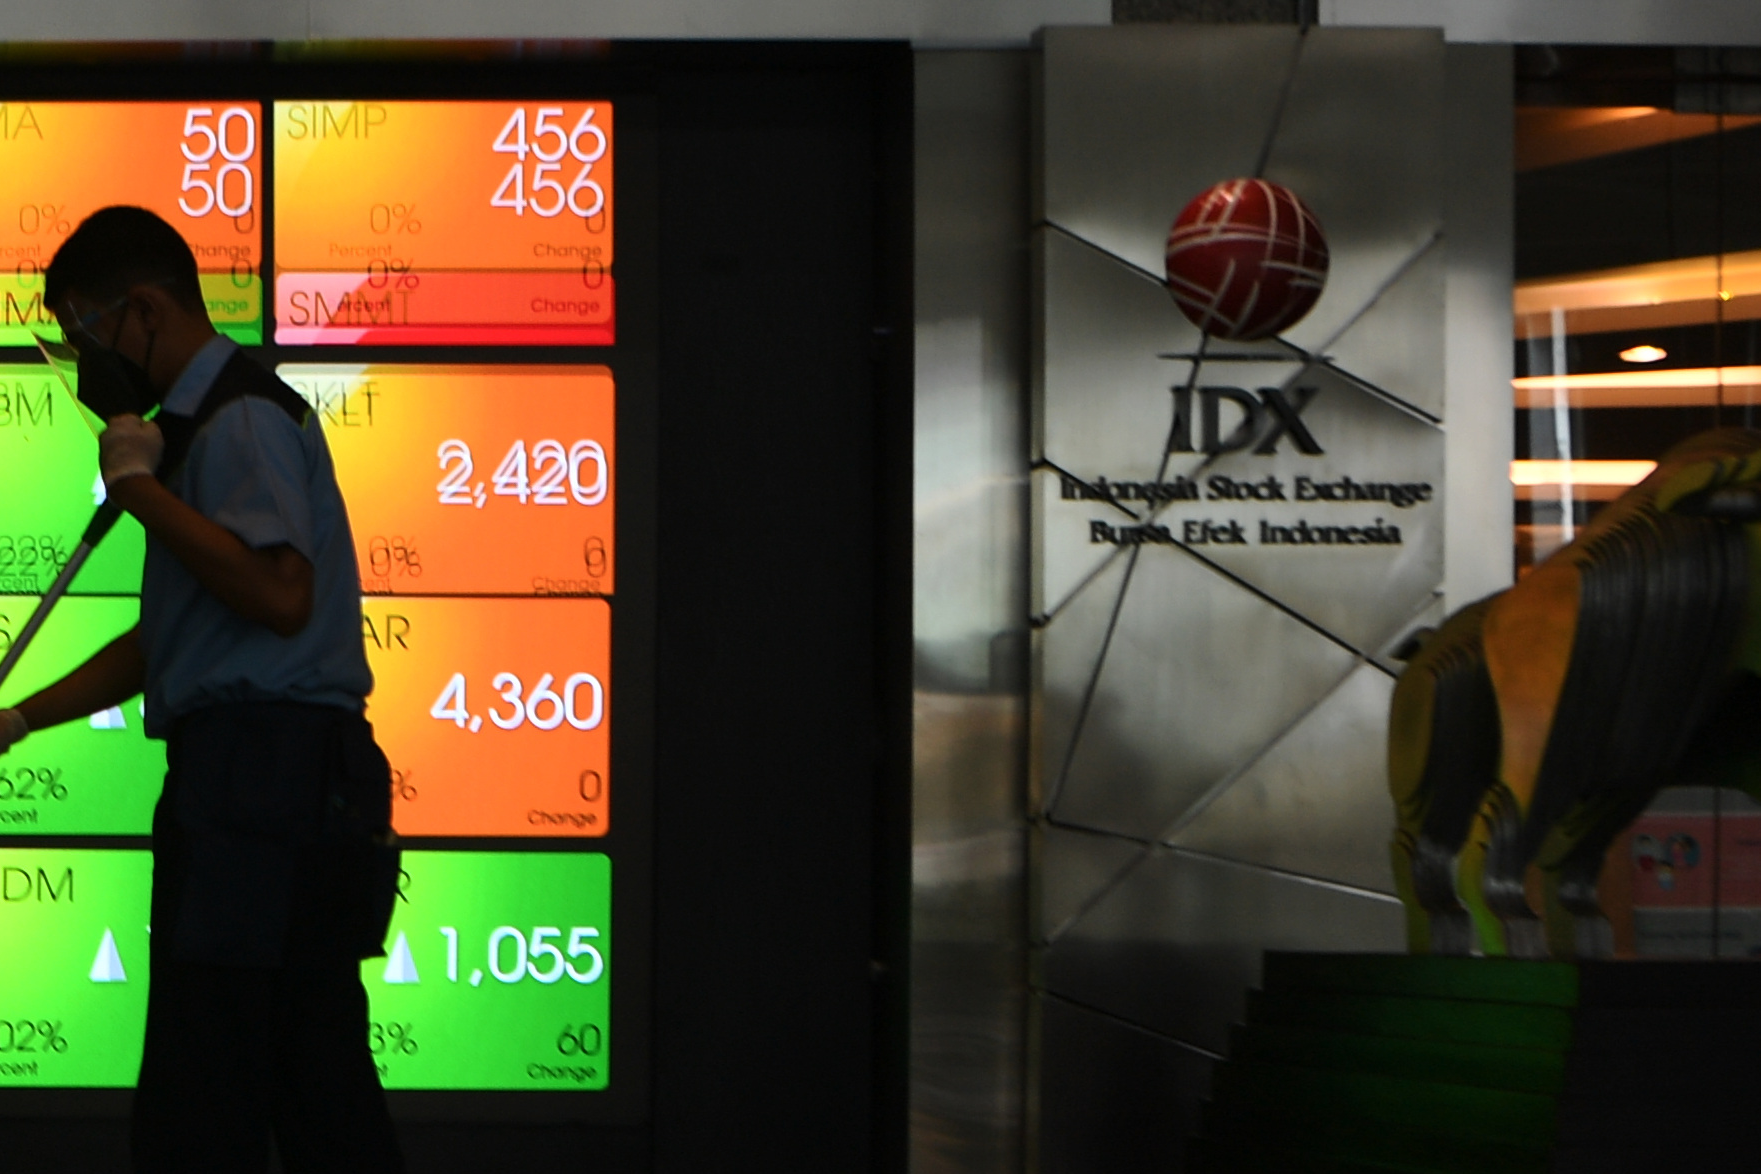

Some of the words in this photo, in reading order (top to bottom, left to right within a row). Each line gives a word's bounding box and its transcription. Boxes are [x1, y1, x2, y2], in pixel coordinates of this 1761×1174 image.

[180, 107, 255, 163] 50
[287, 103, 387, 140] SIMP
[492, 107, 606, 163] 456
[178, 162, 253, 218] 50
[490, 162, 605, 218] 456
[19, 204, 71, 235] 0%
[370, 203, 422, 235] 0%
[533, 243, 602, 260] Change
[1170, 385, 1324, 456] IDX
[437, 438, 607, 509] 2,420
[1061, 476, 1199, 503] Indonesia
[1207, 475, 1287, 502] Stock
[1295, 475, 1432, 508] Exchange
[1089, 520, 1170, 545] Bursa
[1183, 518, 1247, 545] Efek
[1260, 517, 1402, 545] Indonesia
[430, 672, 603, 734] 4,360
[440, 926, 603, 986] 1,055
[557, 1024, 601, 1057] 60
